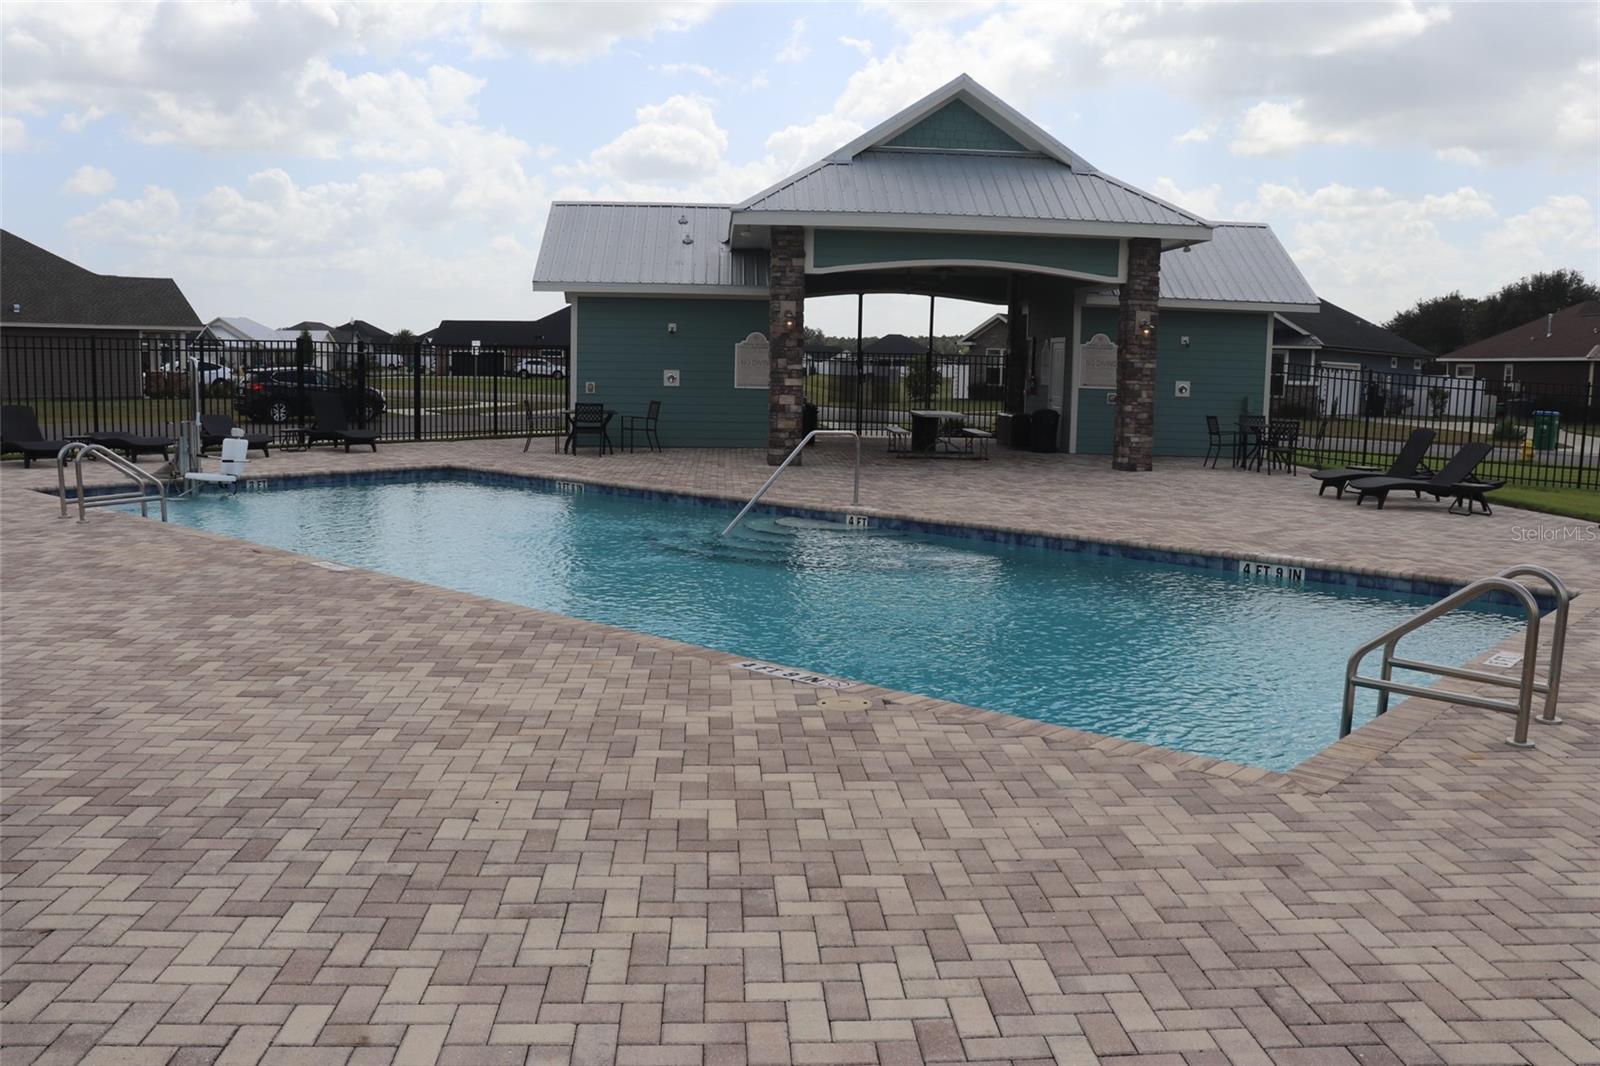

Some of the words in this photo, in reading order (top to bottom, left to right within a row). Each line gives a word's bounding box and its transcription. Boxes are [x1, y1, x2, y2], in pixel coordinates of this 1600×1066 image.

[848, 515, 854, 525] 4
[857, 516, 867, 527] FT
[1243, 563, 1251, 575] 4
[1256, 564, 1270, 577] FT
[1276, 567, 1283, 578] 9
[1289, 568, 1302, 580] IN
